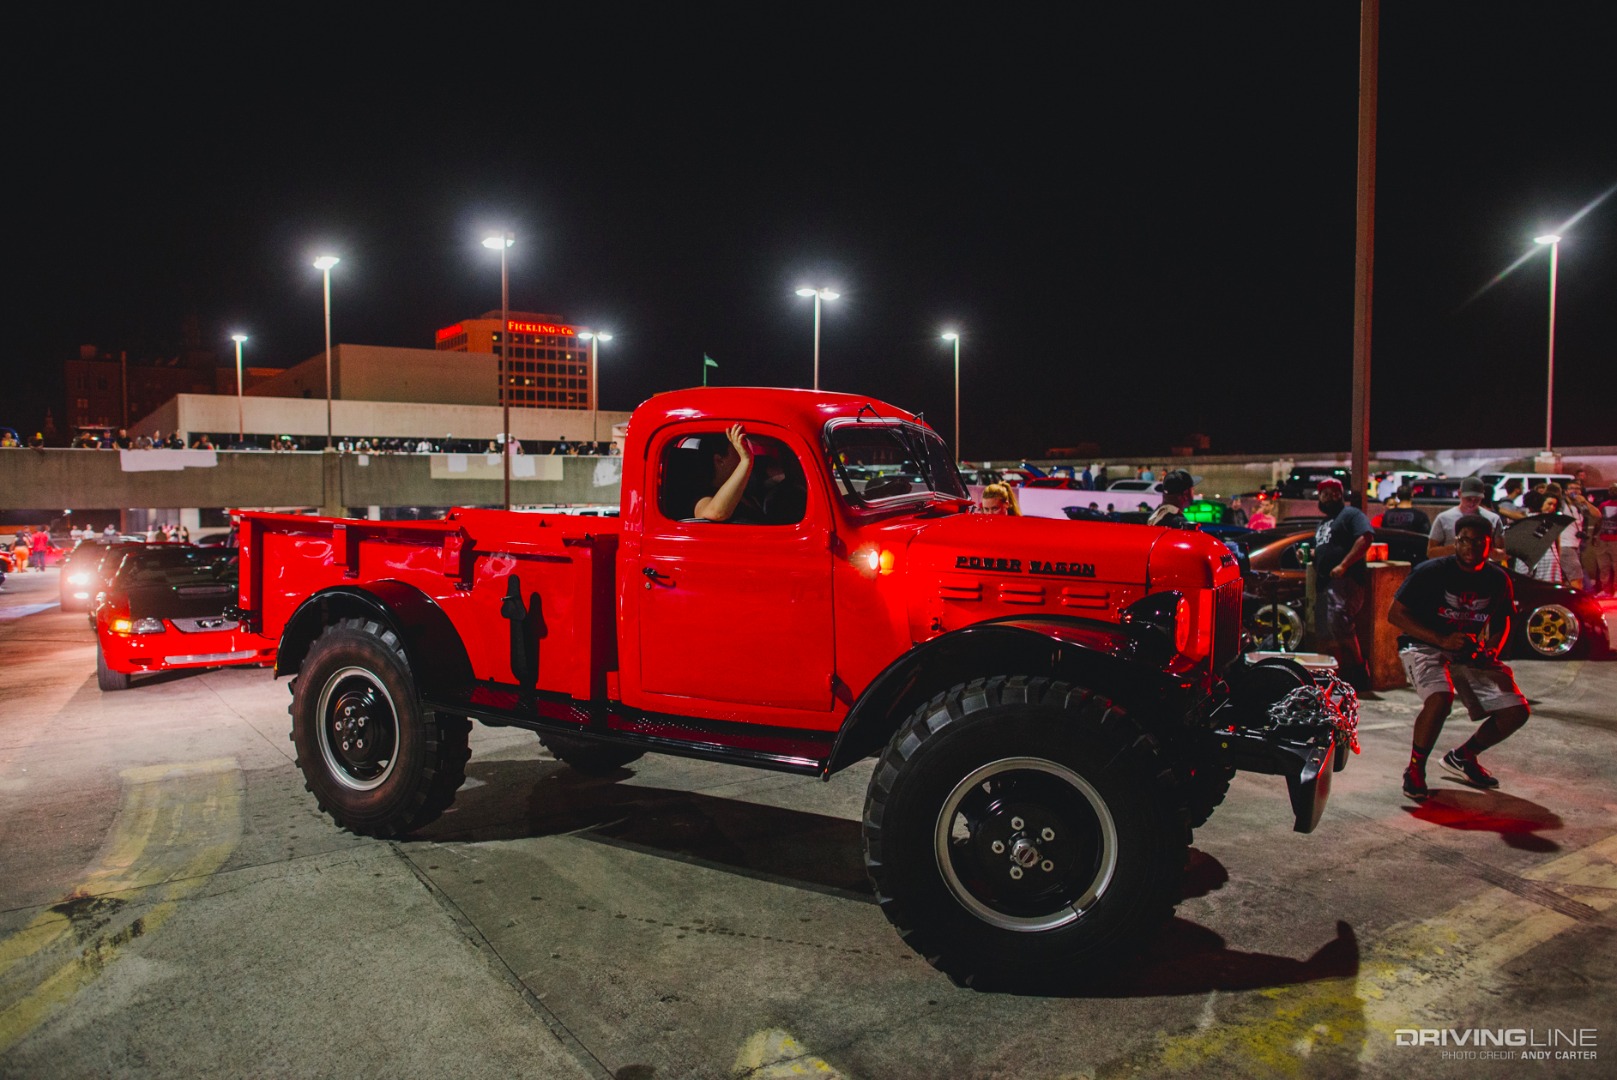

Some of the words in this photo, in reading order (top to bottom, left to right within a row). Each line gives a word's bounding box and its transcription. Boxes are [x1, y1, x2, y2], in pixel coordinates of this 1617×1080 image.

[508, 321, 556, 334] FICKLING
[955, 556, 1022, 572] POWER
[1028, 561, 1096, 577] WAGON
